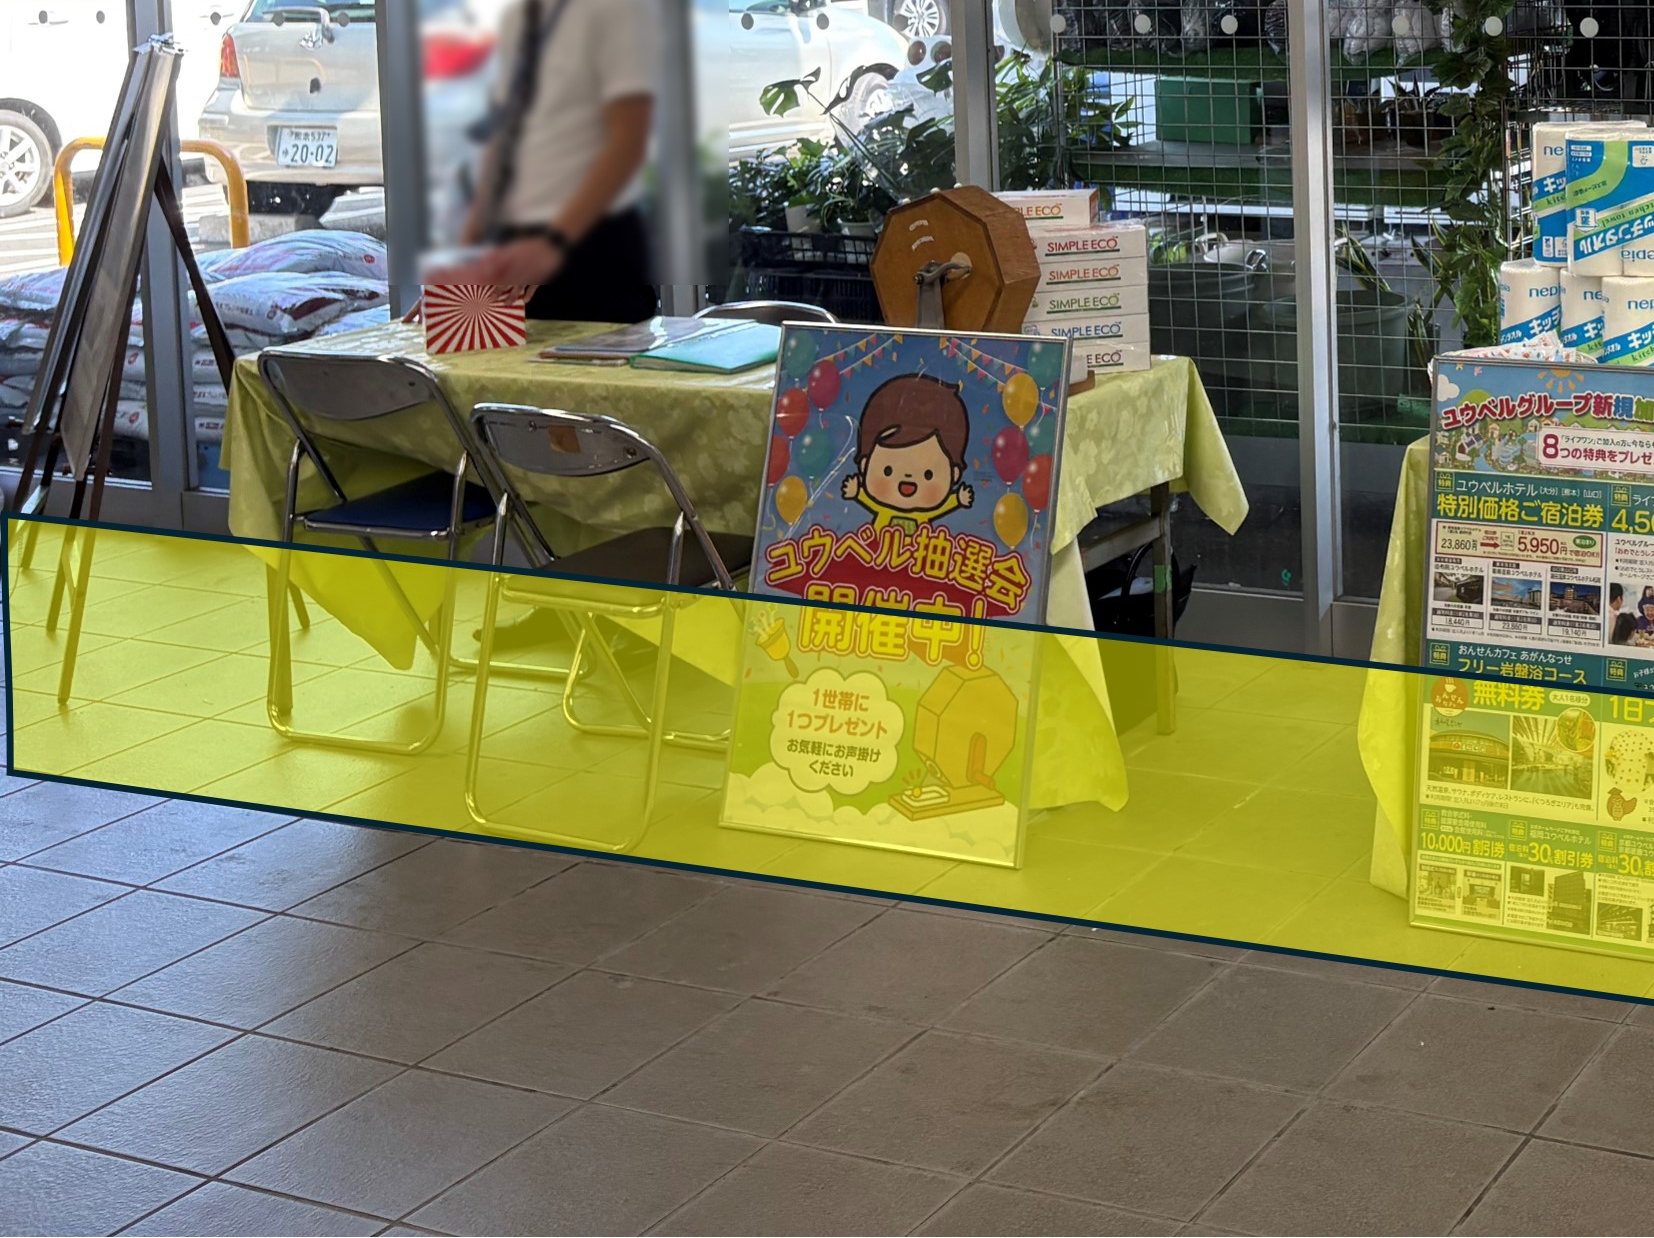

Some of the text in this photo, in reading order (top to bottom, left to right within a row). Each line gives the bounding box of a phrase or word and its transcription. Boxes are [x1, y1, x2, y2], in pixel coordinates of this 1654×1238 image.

[1035, 203, 1061, 216] ECO
[1047, 237, 1117, 252] SIMPLE ECO
[1049, 266, 1119, 281] SIMPLE ECO
[1049, 294, 1119, 310] SIMPLE ECO
[1051, 322, 1121, 337] SIMPLE ECO
[1096, 351, 1122, 364] ECO
[1456, 480, 1537, 496] ユウベルホテル
[1437, 493, 1604, 528] 特別価格ご宿泊券
[766, 526, 1029, 611] ユウベル抽選会
[800, 584, 987, 669] 開催中!
[1458, 645, 1572, 665] おんせんカフェ あがんなっせ
[1458, 658, 1587, 685] フリー岩盤浴コース
[812, 688, 870, 713] 1世帯に
[1473, 679, 1545, 711] 無料券
[787, 710, 888, 740] 1つプレゼント
[786, 738, 882, 763] お気軽にお声掛け
[808, 759, 854, 778] ください
[1421, 832, 1505, 858] 10,000円 割引券
